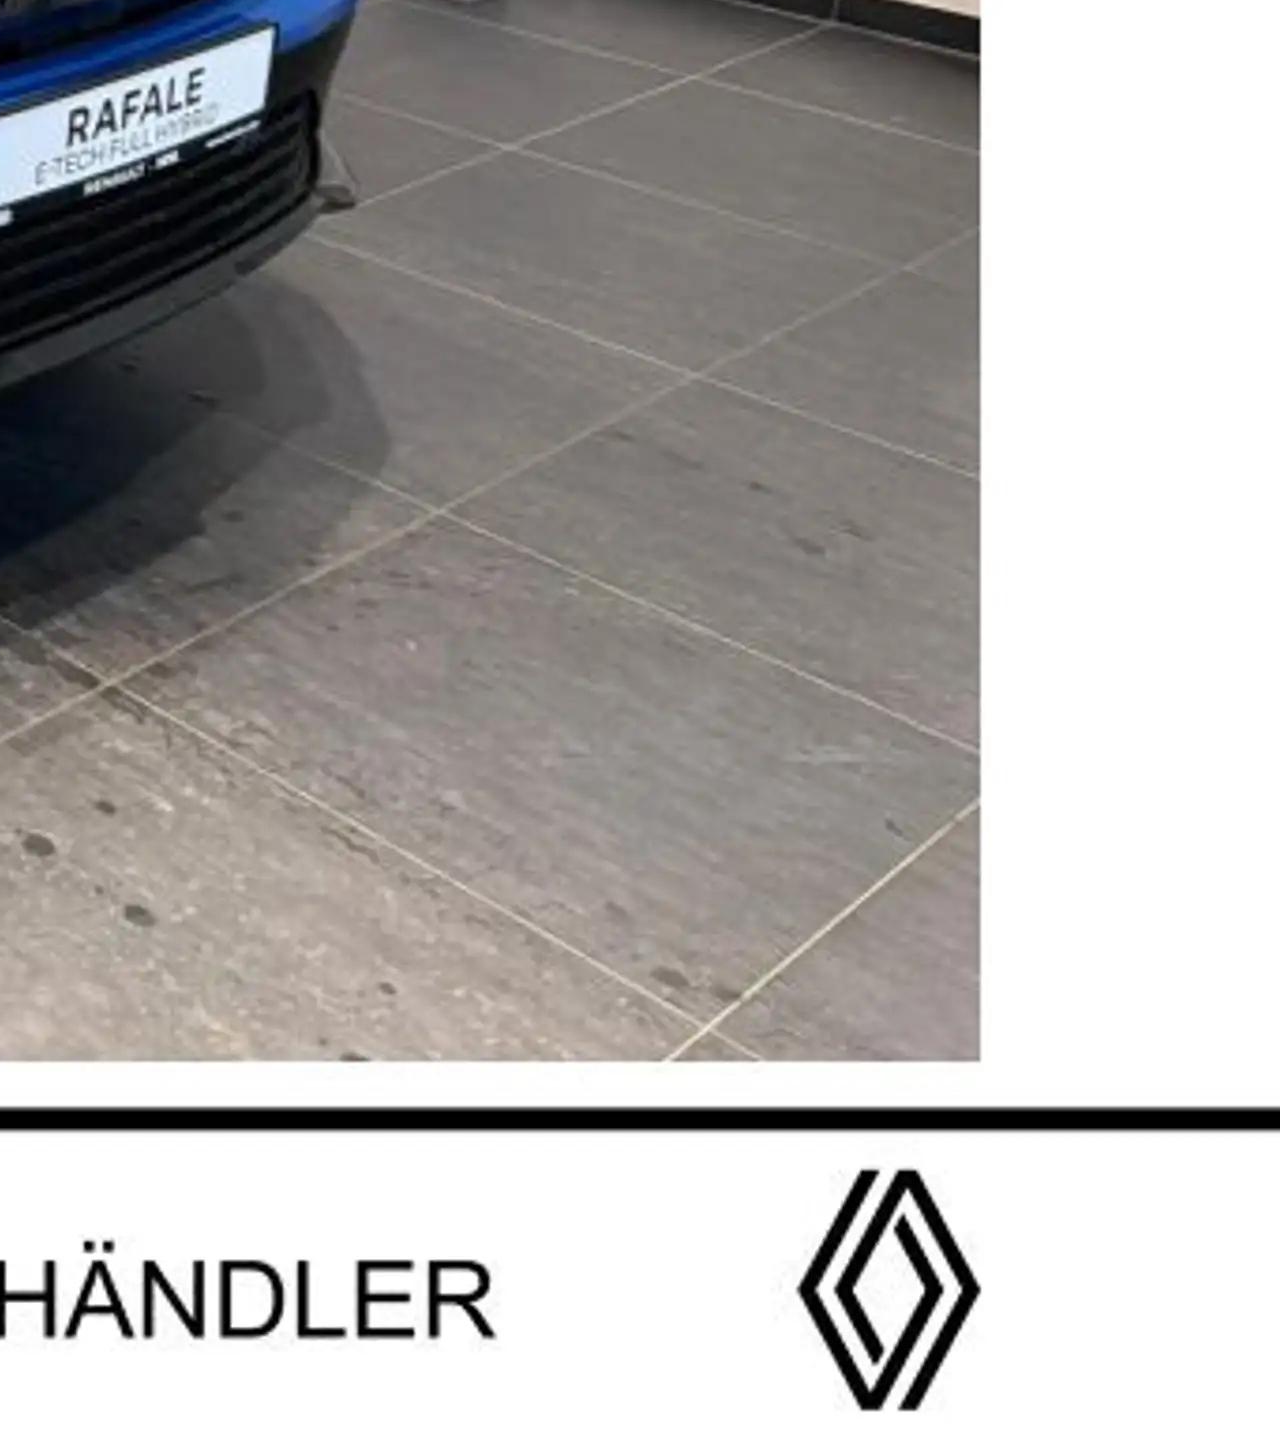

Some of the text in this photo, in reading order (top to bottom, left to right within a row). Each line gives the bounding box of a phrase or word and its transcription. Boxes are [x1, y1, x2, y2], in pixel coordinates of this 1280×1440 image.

[65, 66, 206, 148] RAFALE
[34, 146, 104, 186] E-TECH
[110, 126, 154, 160] FULL
